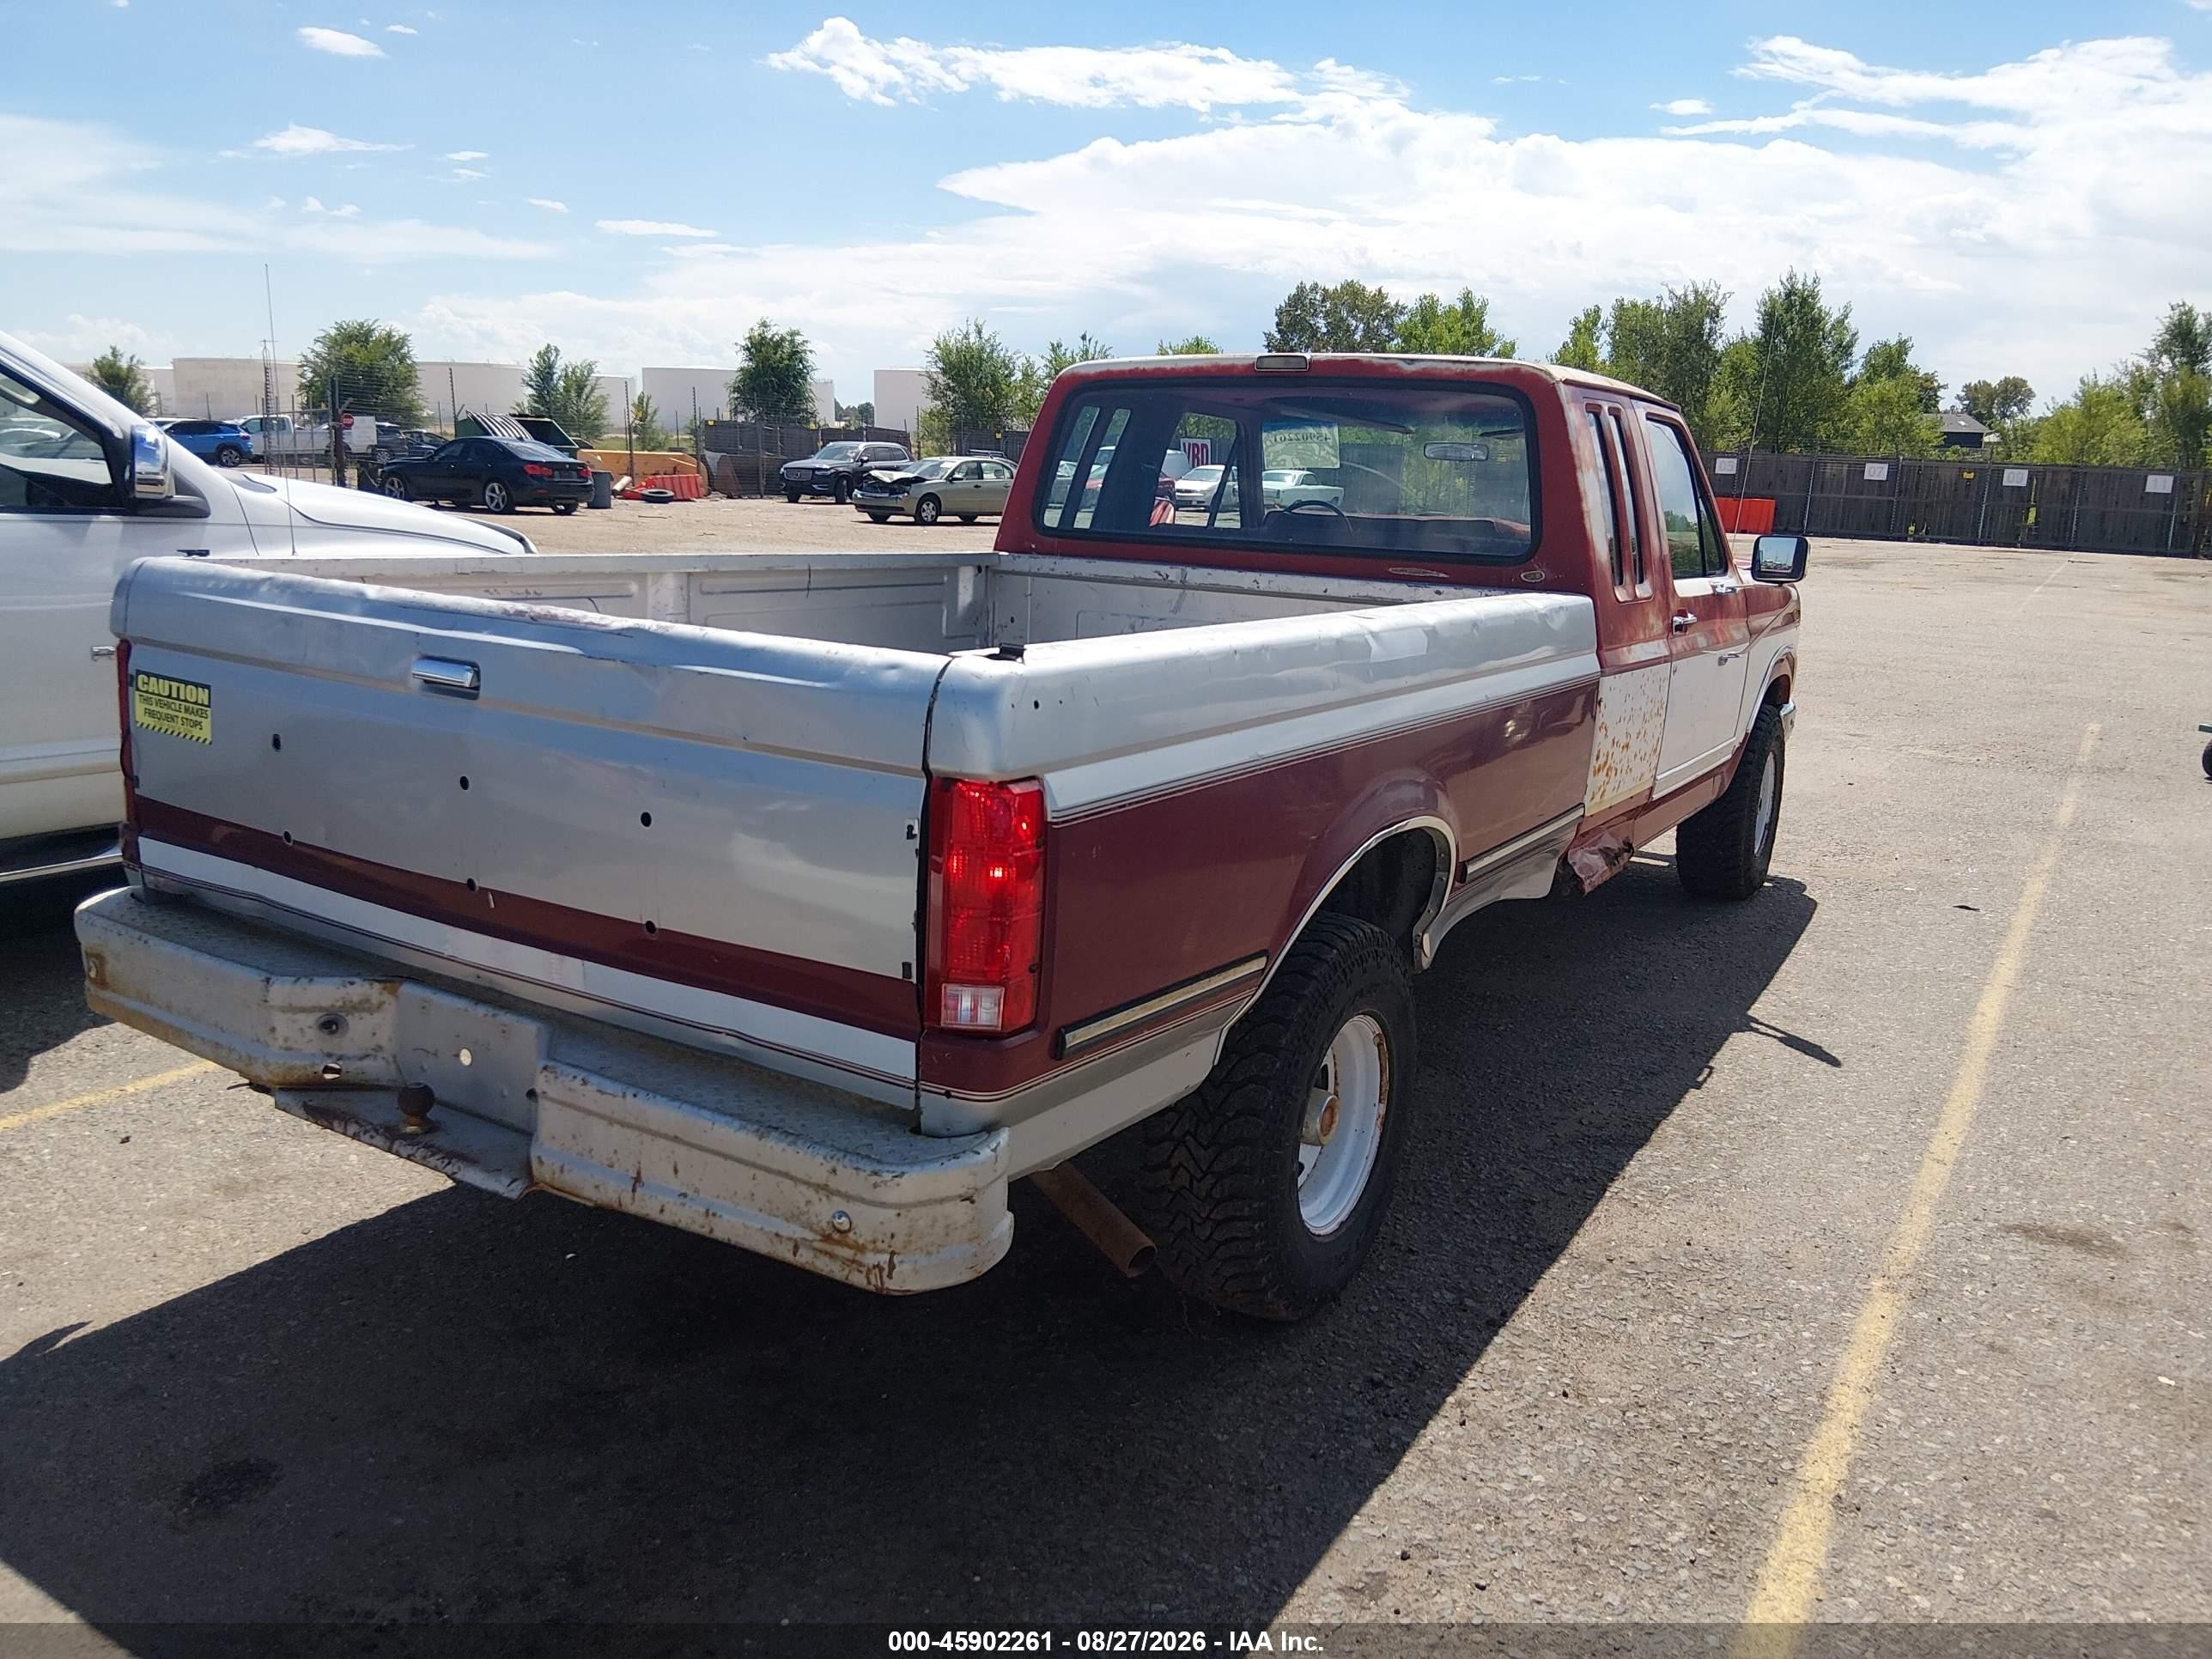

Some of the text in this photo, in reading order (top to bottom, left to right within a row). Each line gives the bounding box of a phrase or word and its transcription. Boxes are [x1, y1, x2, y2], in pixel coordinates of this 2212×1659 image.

[1868, 466, 1884, 477] 07
[137, 674, 210, 705] CAUTION
[138, 694, 209, 720] THIS VEHICLE MAKES
[143, 708, 179, 725] FREQUENT
[181, 716, 204, 731] STOPS
